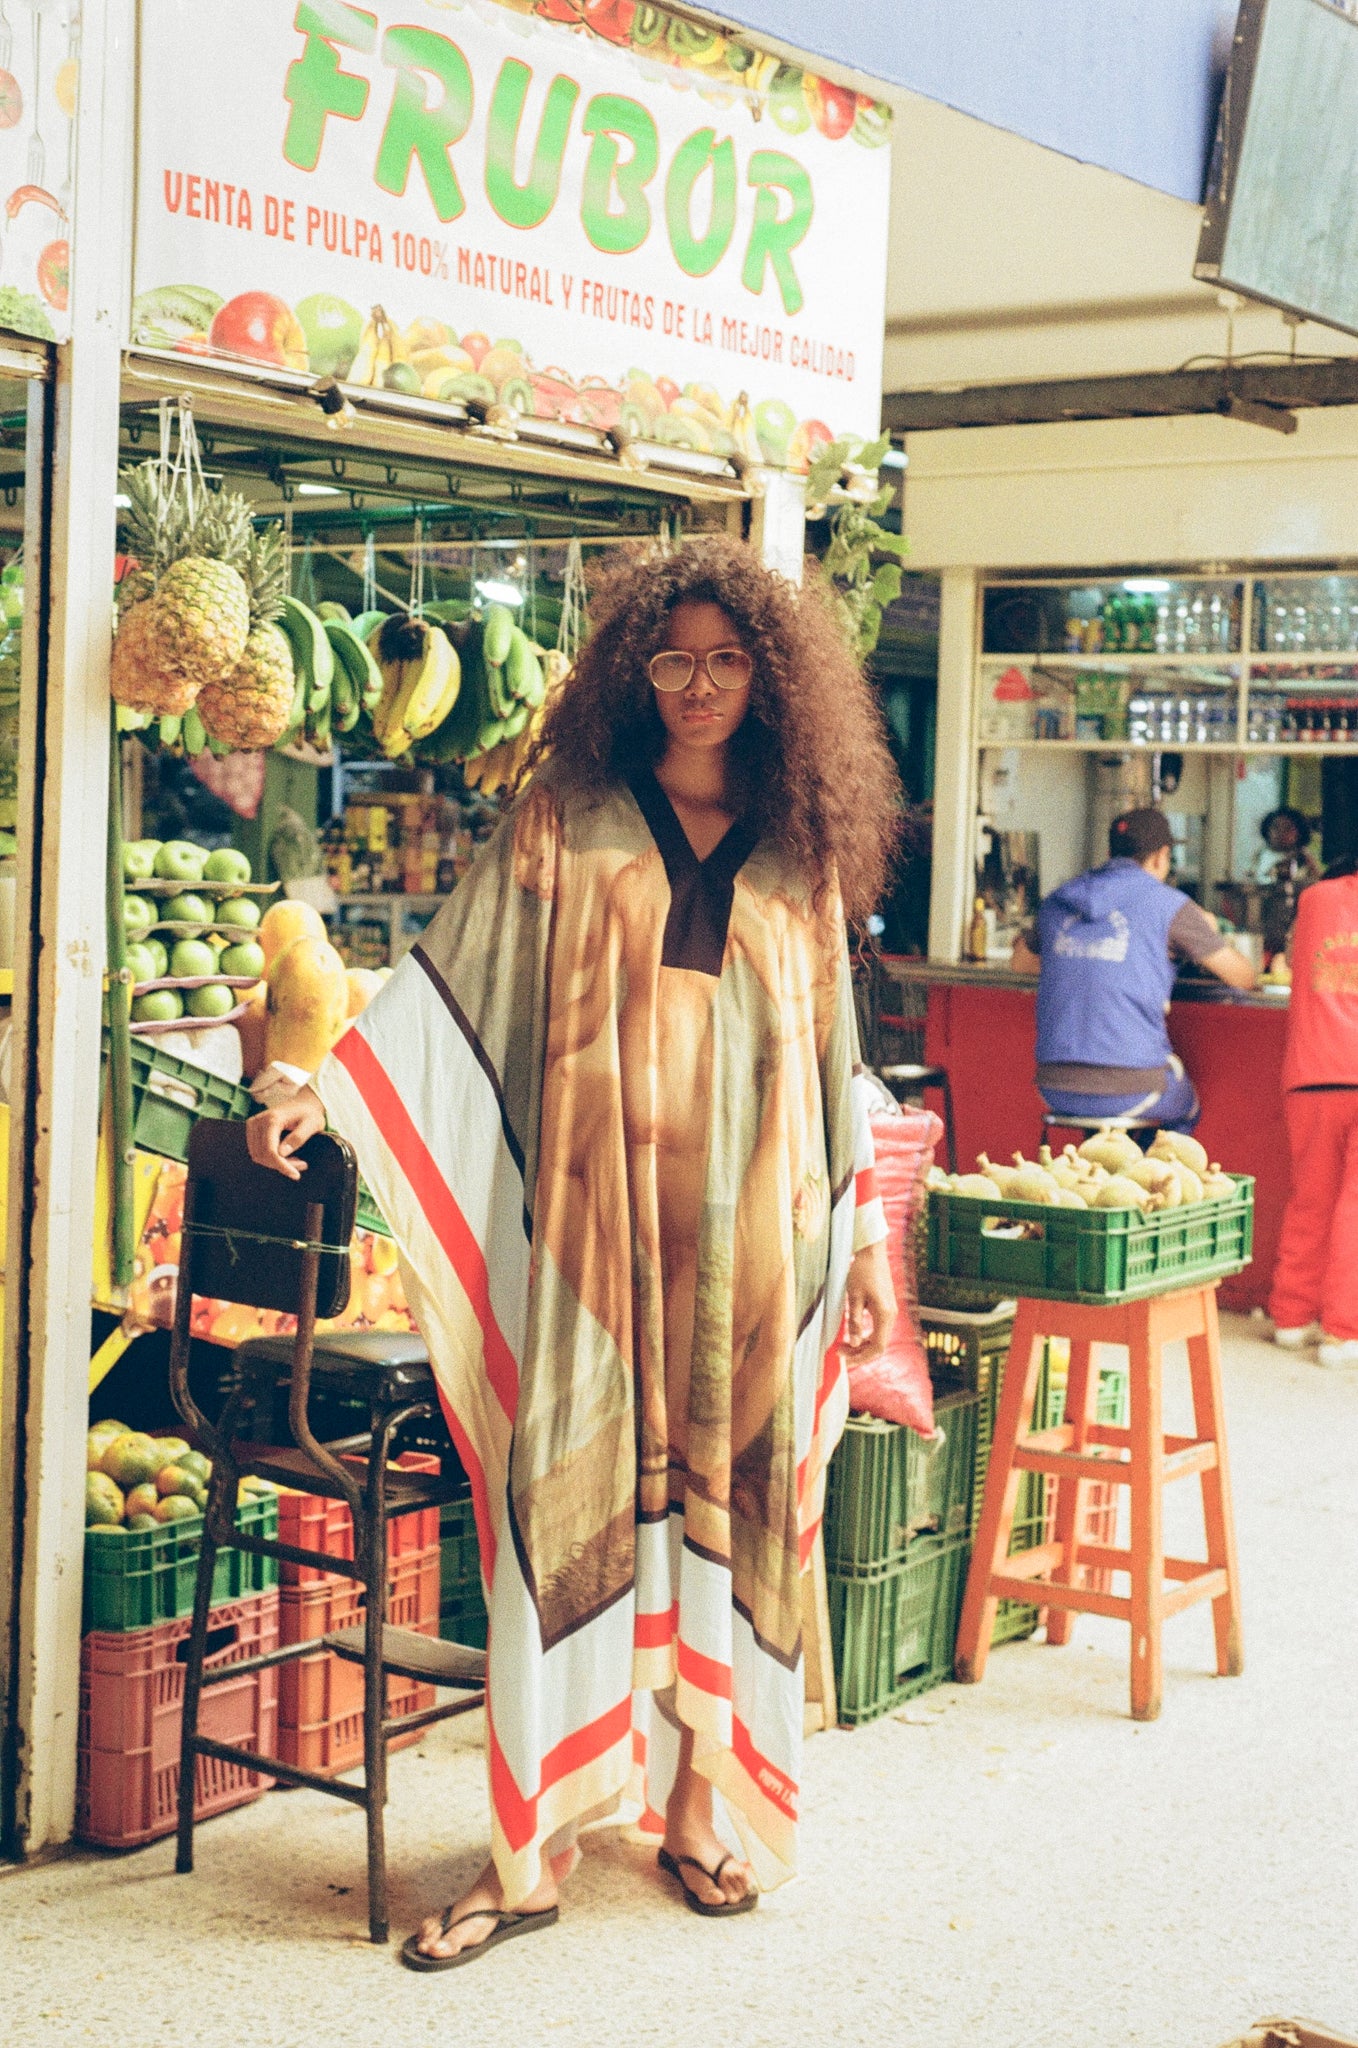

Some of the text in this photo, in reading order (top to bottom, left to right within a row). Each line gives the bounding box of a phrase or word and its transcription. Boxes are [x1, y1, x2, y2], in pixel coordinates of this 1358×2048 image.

[163, 169, 856, 383] VENTA DE PULPA 100% NATURAL Y FRUTAS DE LA MEJOR CALIDAD
[283, 0, 815, 316] FRUBOR
